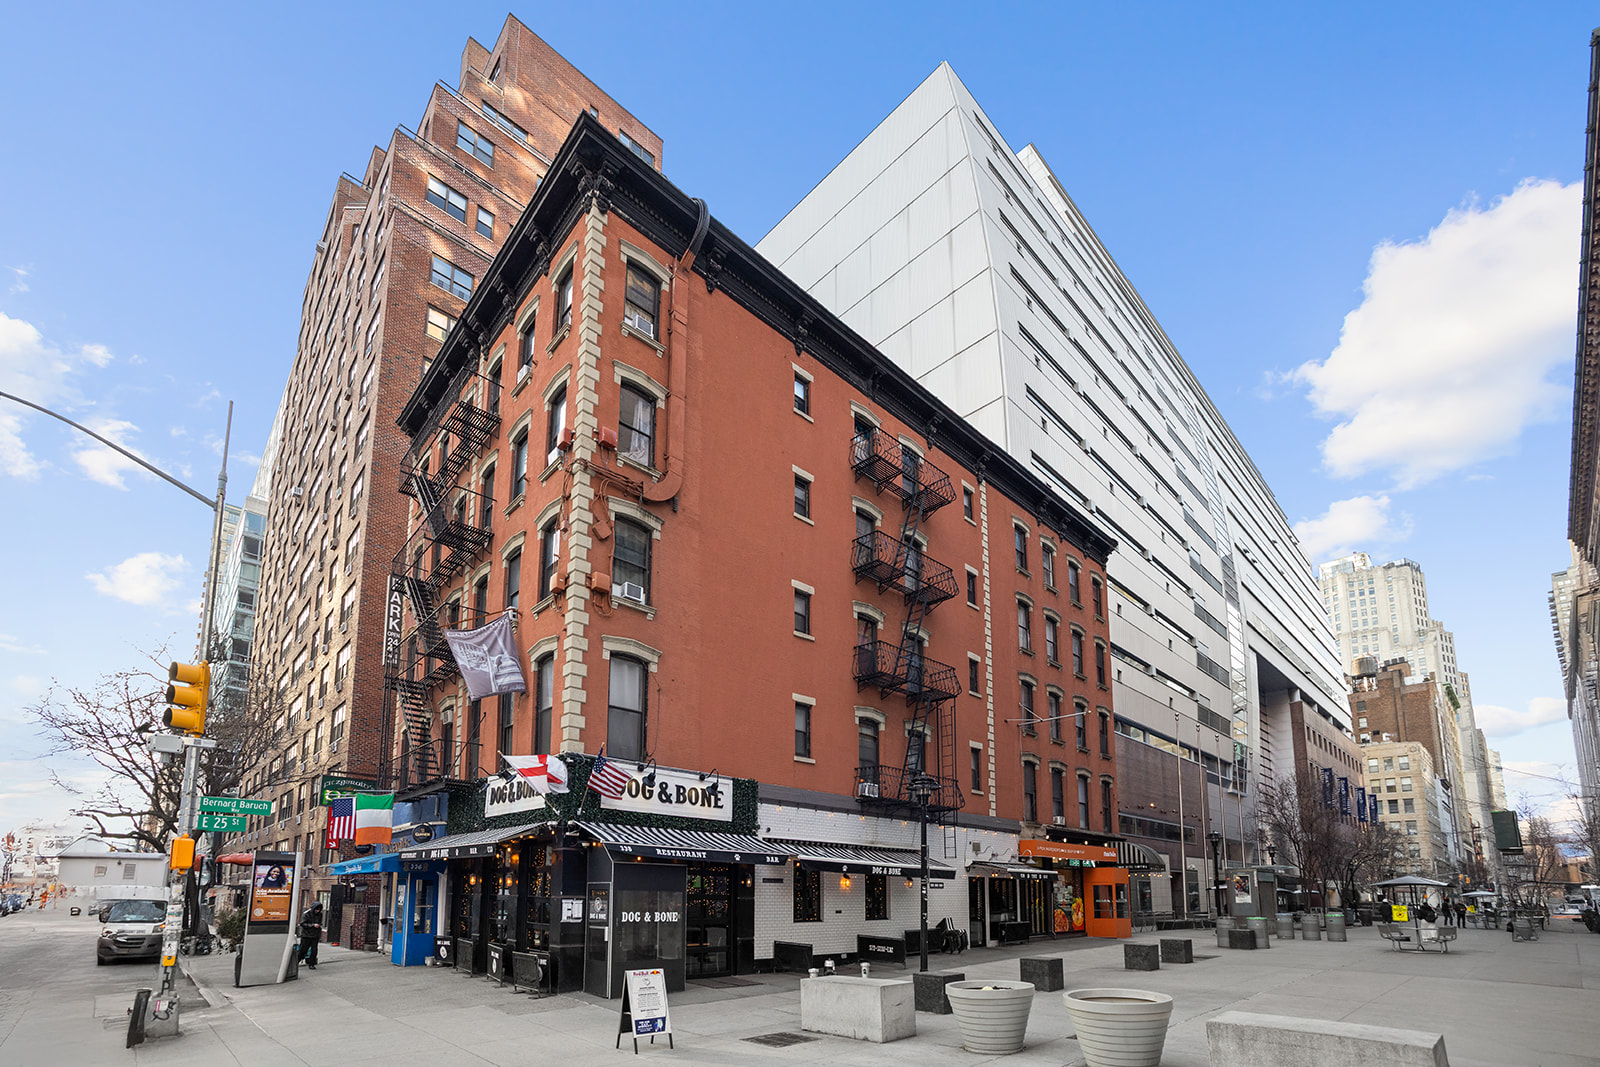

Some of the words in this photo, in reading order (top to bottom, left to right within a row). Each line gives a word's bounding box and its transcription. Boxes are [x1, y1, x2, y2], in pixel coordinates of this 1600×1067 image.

[387, 631, 400, 639] OPEN
[489, 785, 508, 806] DOG
[508, 782, 516, 804] &
[516, 780, 541, 801] BON
[620, 778, 654, 800] OG
[657, 781, 673, 804] &
[675, 784, 724, 809] BONE
[202, 797, 237, 808] Bernard
[239, 800, 268, 810] Baruch
[202, 816, 209, 828] E
[213, 817, 228, 829] 25
[232, 818, 240, 826] St
[656, 848, 707, 859] RESTAURANT
[621, 911, 641, 922] DOG
[643, 911, 651, 922] &
[654, 911, 678, 922] BONE
